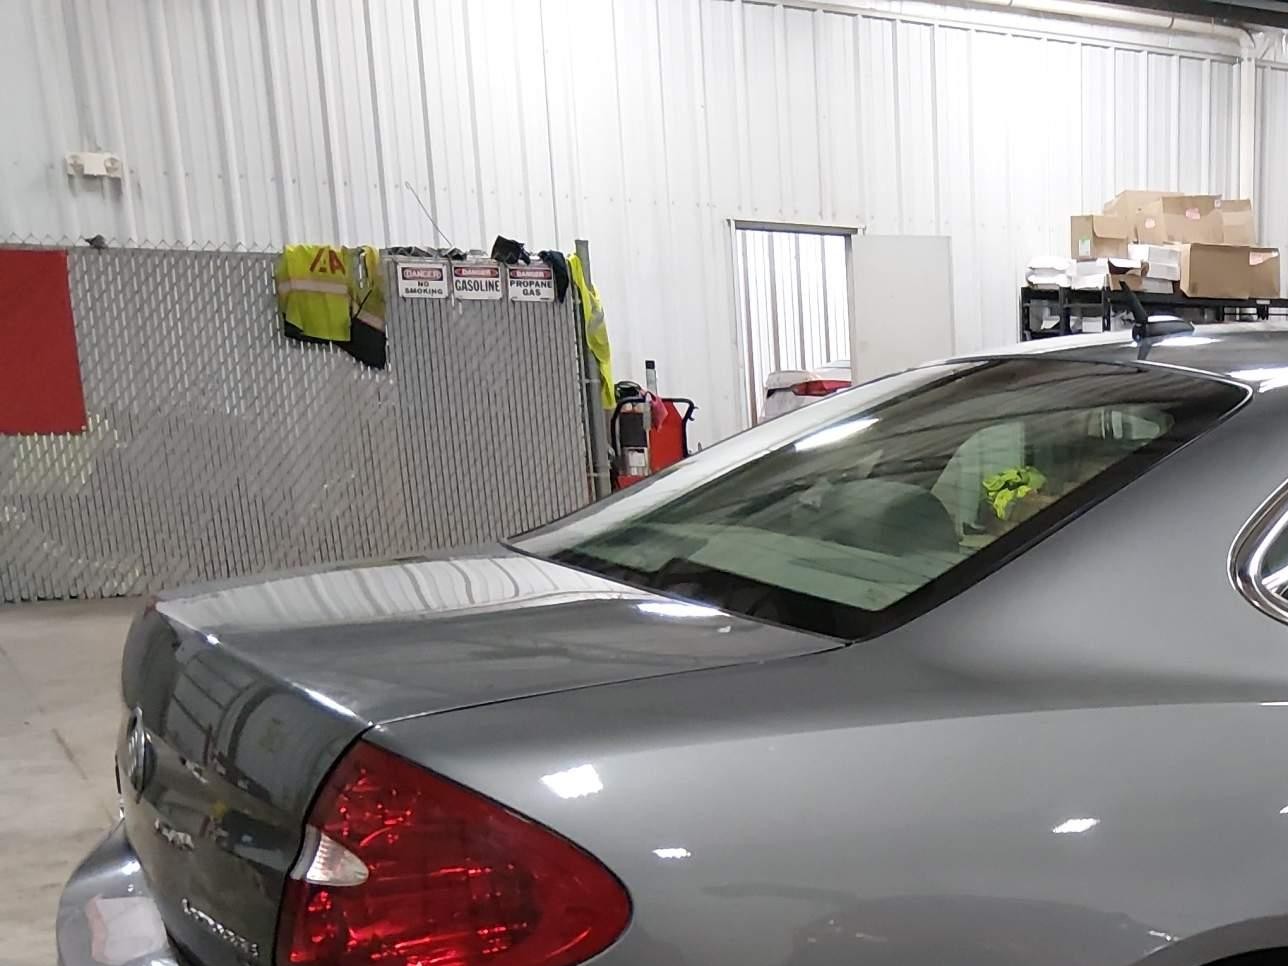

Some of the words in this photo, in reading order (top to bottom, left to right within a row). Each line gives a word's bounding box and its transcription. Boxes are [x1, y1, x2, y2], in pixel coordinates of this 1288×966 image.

[406, 269, 440, 278] DANGER
[455, 280, 500, 292] GASOLINE
[510, 280, 553, 288] PROPANE
